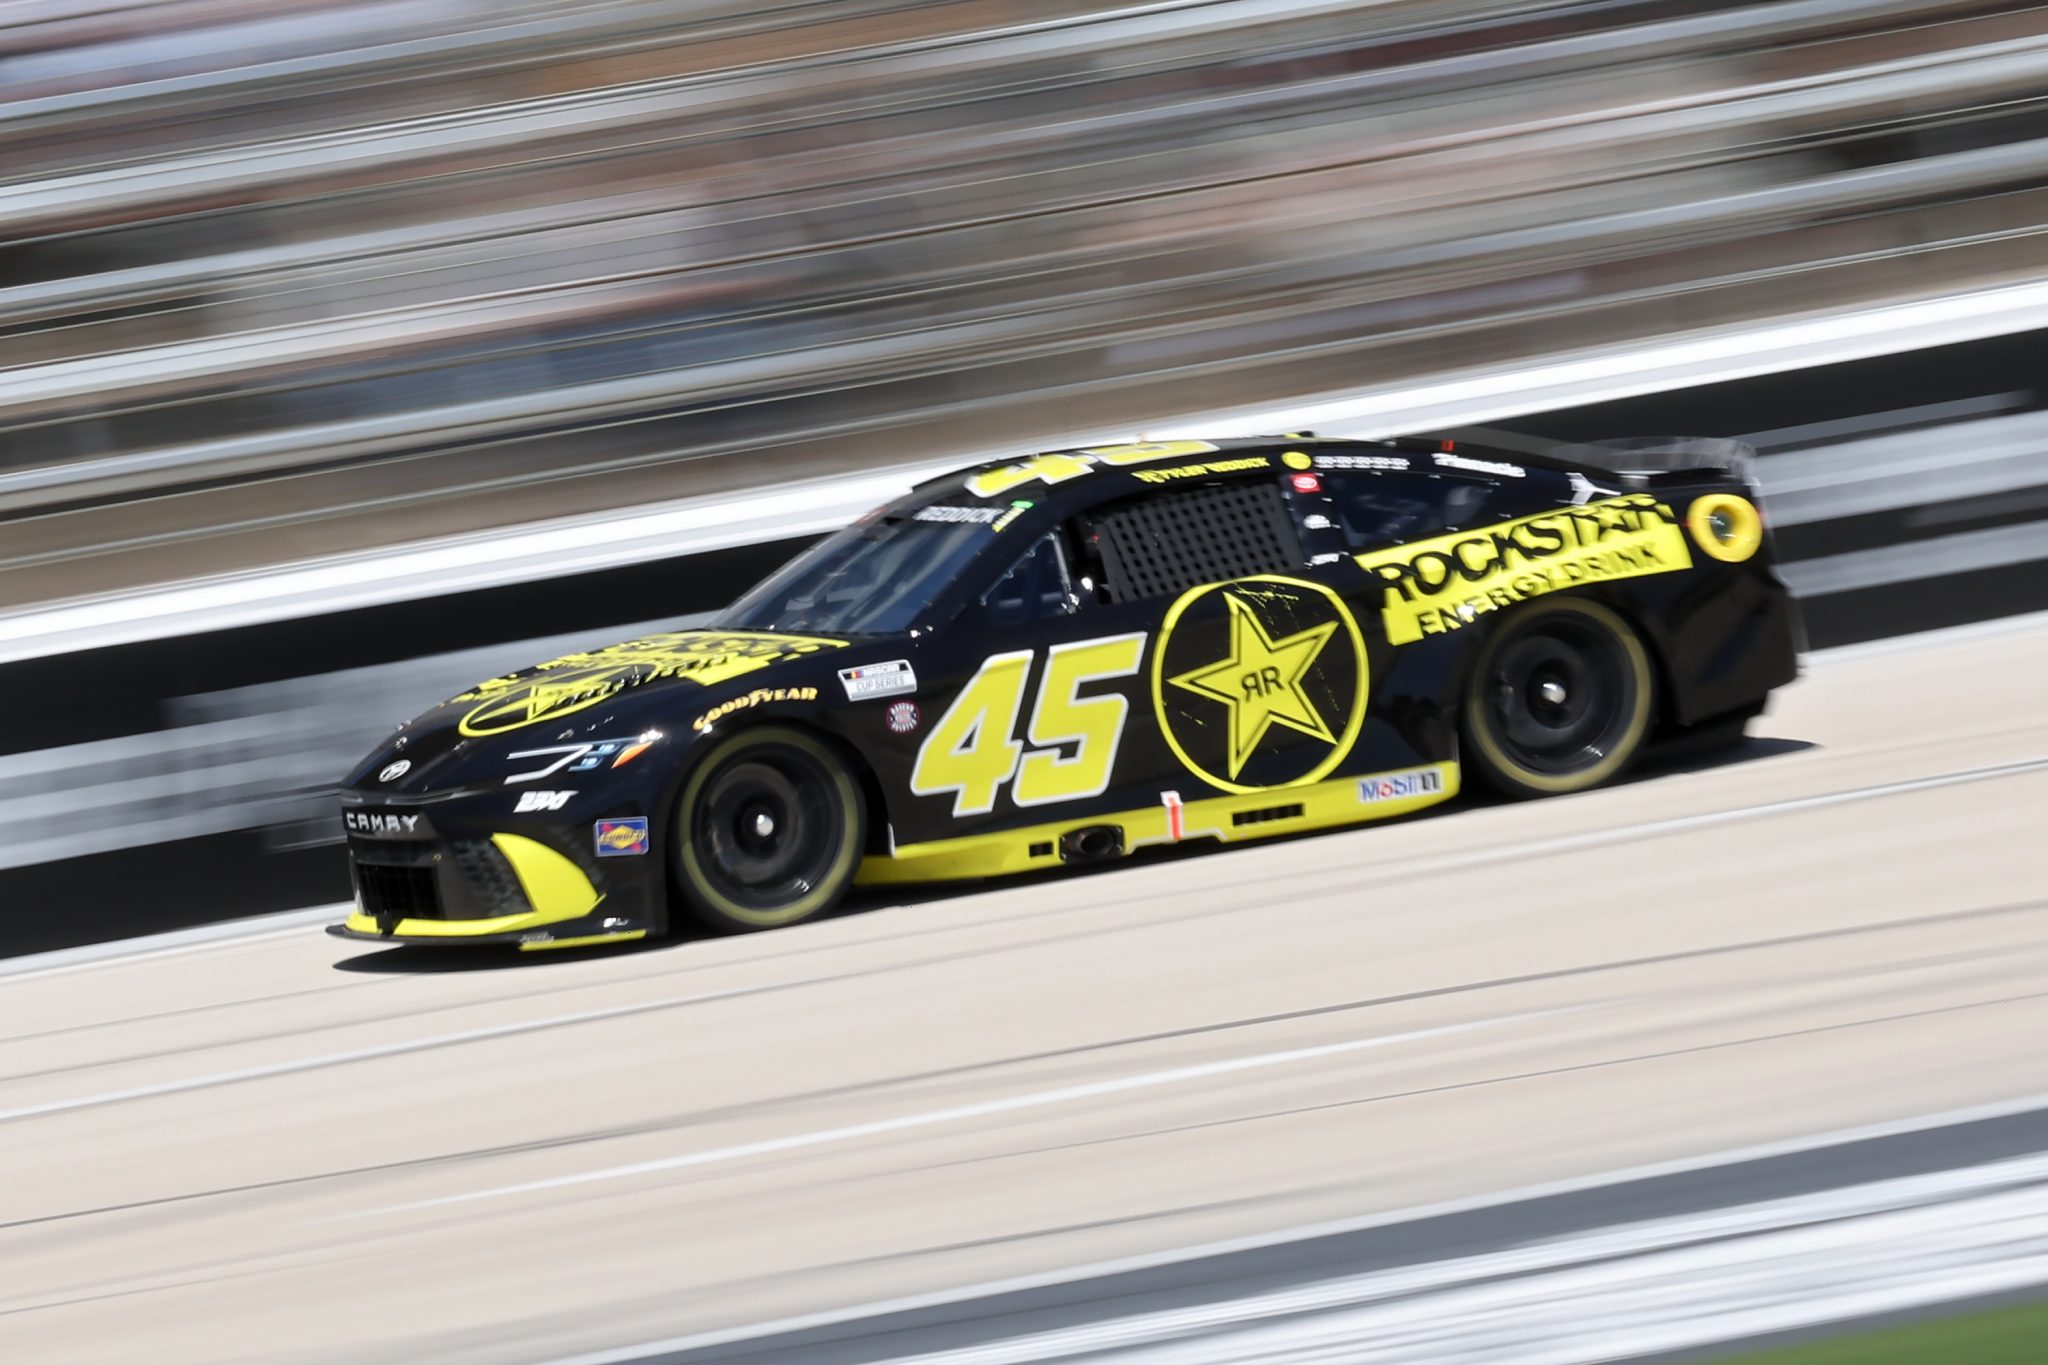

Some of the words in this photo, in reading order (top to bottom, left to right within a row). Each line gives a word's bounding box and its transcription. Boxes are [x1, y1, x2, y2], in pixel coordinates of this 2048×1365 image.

[912, 505, 1005, 523] REDDICK
[1371, 495, 1676, 600] ROCKSTAR
[1417, 566, 1556, 636] ENERGY
[1560, 540, 1667, 583] DRINK
[856, 679, 874, 692] CUP
[875, 675, 905, 690] SERIES
[863, 663, 900, 678] NASCAR
[692, 687, 819, 732] GOODYEAR
[911, 632, 1147, 816] 45
[346, 812, 418, 832] CAMRY
